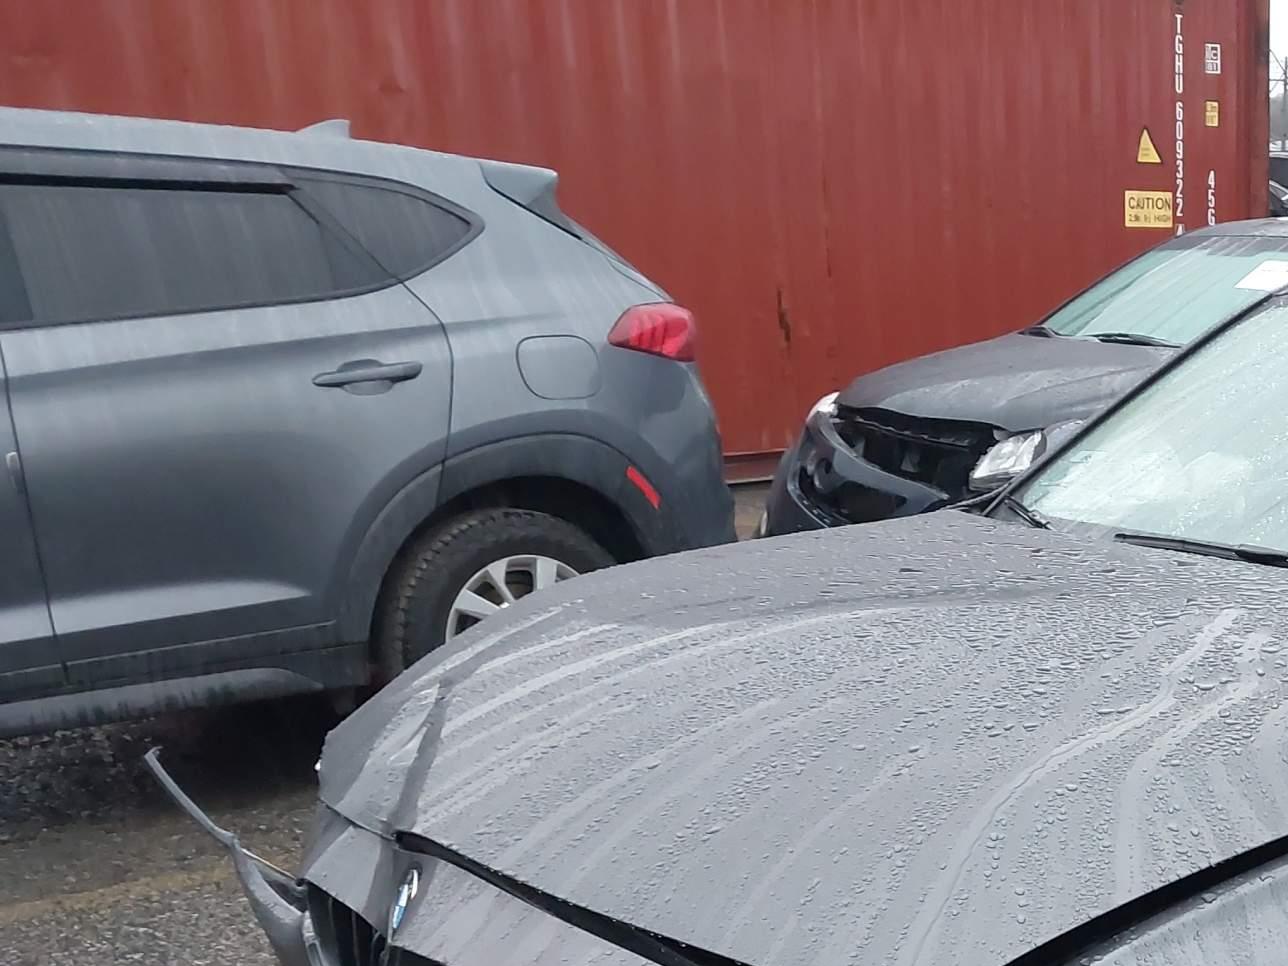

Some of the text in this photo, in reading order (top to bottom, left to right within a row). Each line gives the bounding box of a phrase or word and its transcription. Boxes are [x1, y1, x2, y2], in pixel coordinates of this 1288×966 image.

[1175, 14, 1183, 94] TGHU
[1175, 101, 1183, 217] 609322
[1128, 196, 1171, 211] CAUTION
